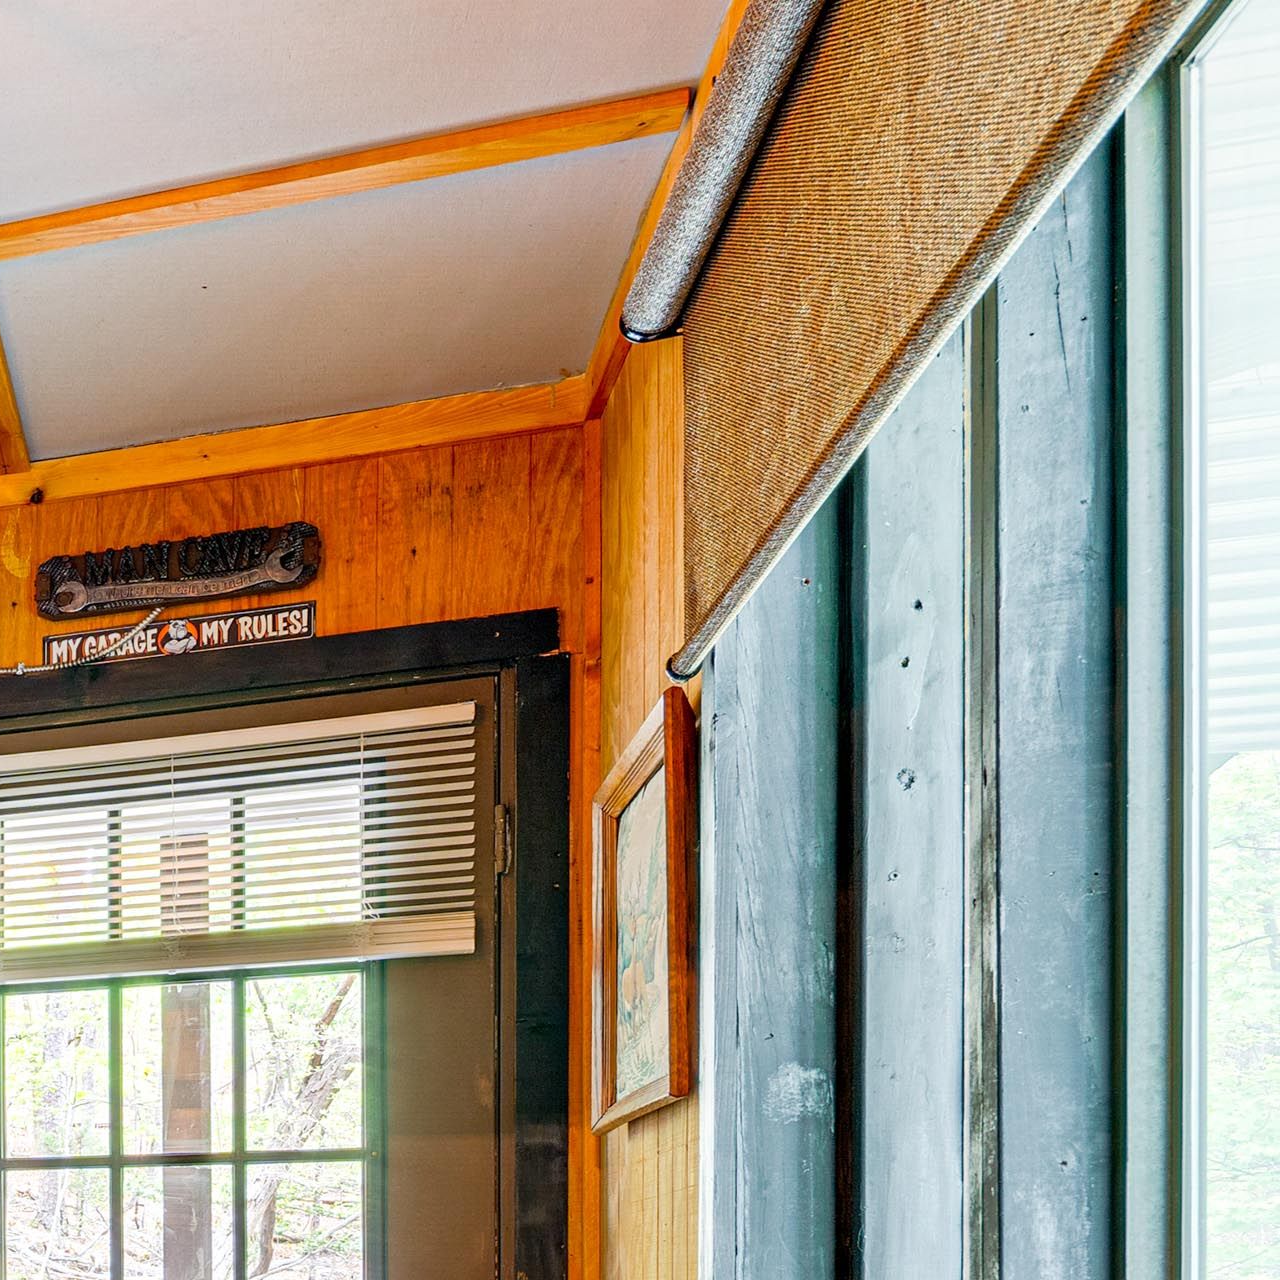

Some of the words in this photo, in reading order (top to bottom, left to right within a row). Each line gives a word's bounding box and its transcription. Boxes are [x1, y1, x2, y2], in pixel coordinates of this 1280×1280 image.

[85, 542, 170, 585] MAN
[179, 526, 270, 576] CAVE
[51, 637, 83, 664] MY
[84, 628, 158, 660] GARAGE
[202, 619, 234, 646] MY
[238, 608, 308, 642] RULES!
